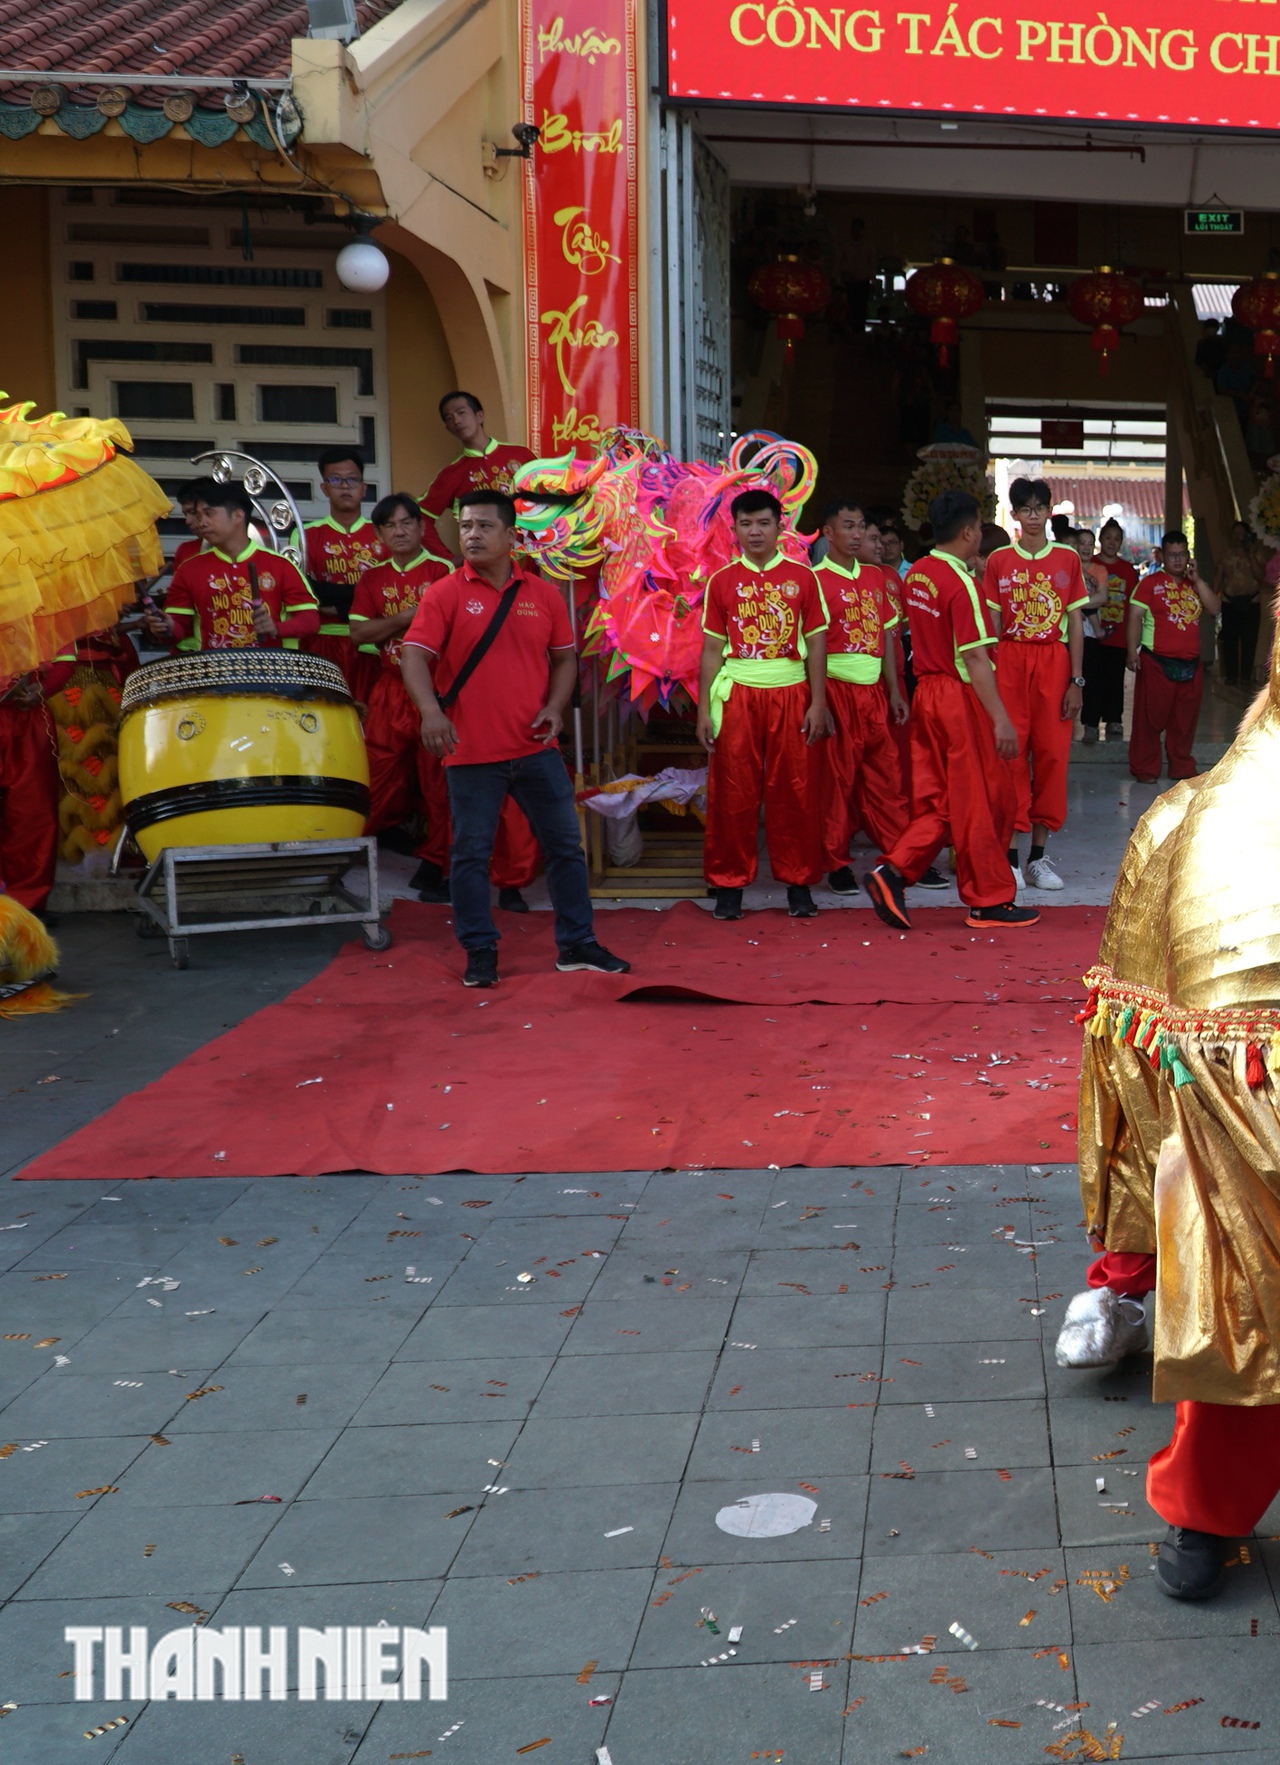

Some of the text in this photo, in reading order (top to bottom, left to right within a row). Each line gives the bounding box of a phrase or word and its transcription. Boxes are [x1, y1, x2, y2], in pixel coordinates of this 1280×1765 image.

[730, 0, 885, 53] CÔNG
[897, 3, 1004, 59] TÁC
[1016, 12, 1198, 71] PHÒNG
[538, 109, 623, 154] Bình
[1198, 213, 1230, 222] EXIT
[553, 206, 622, 275] Tây
[540, 295, 619, 397] Xuân
[738, 598, 757, 619] HÀO
[1026, 598, 1048, 617] DŨNG
